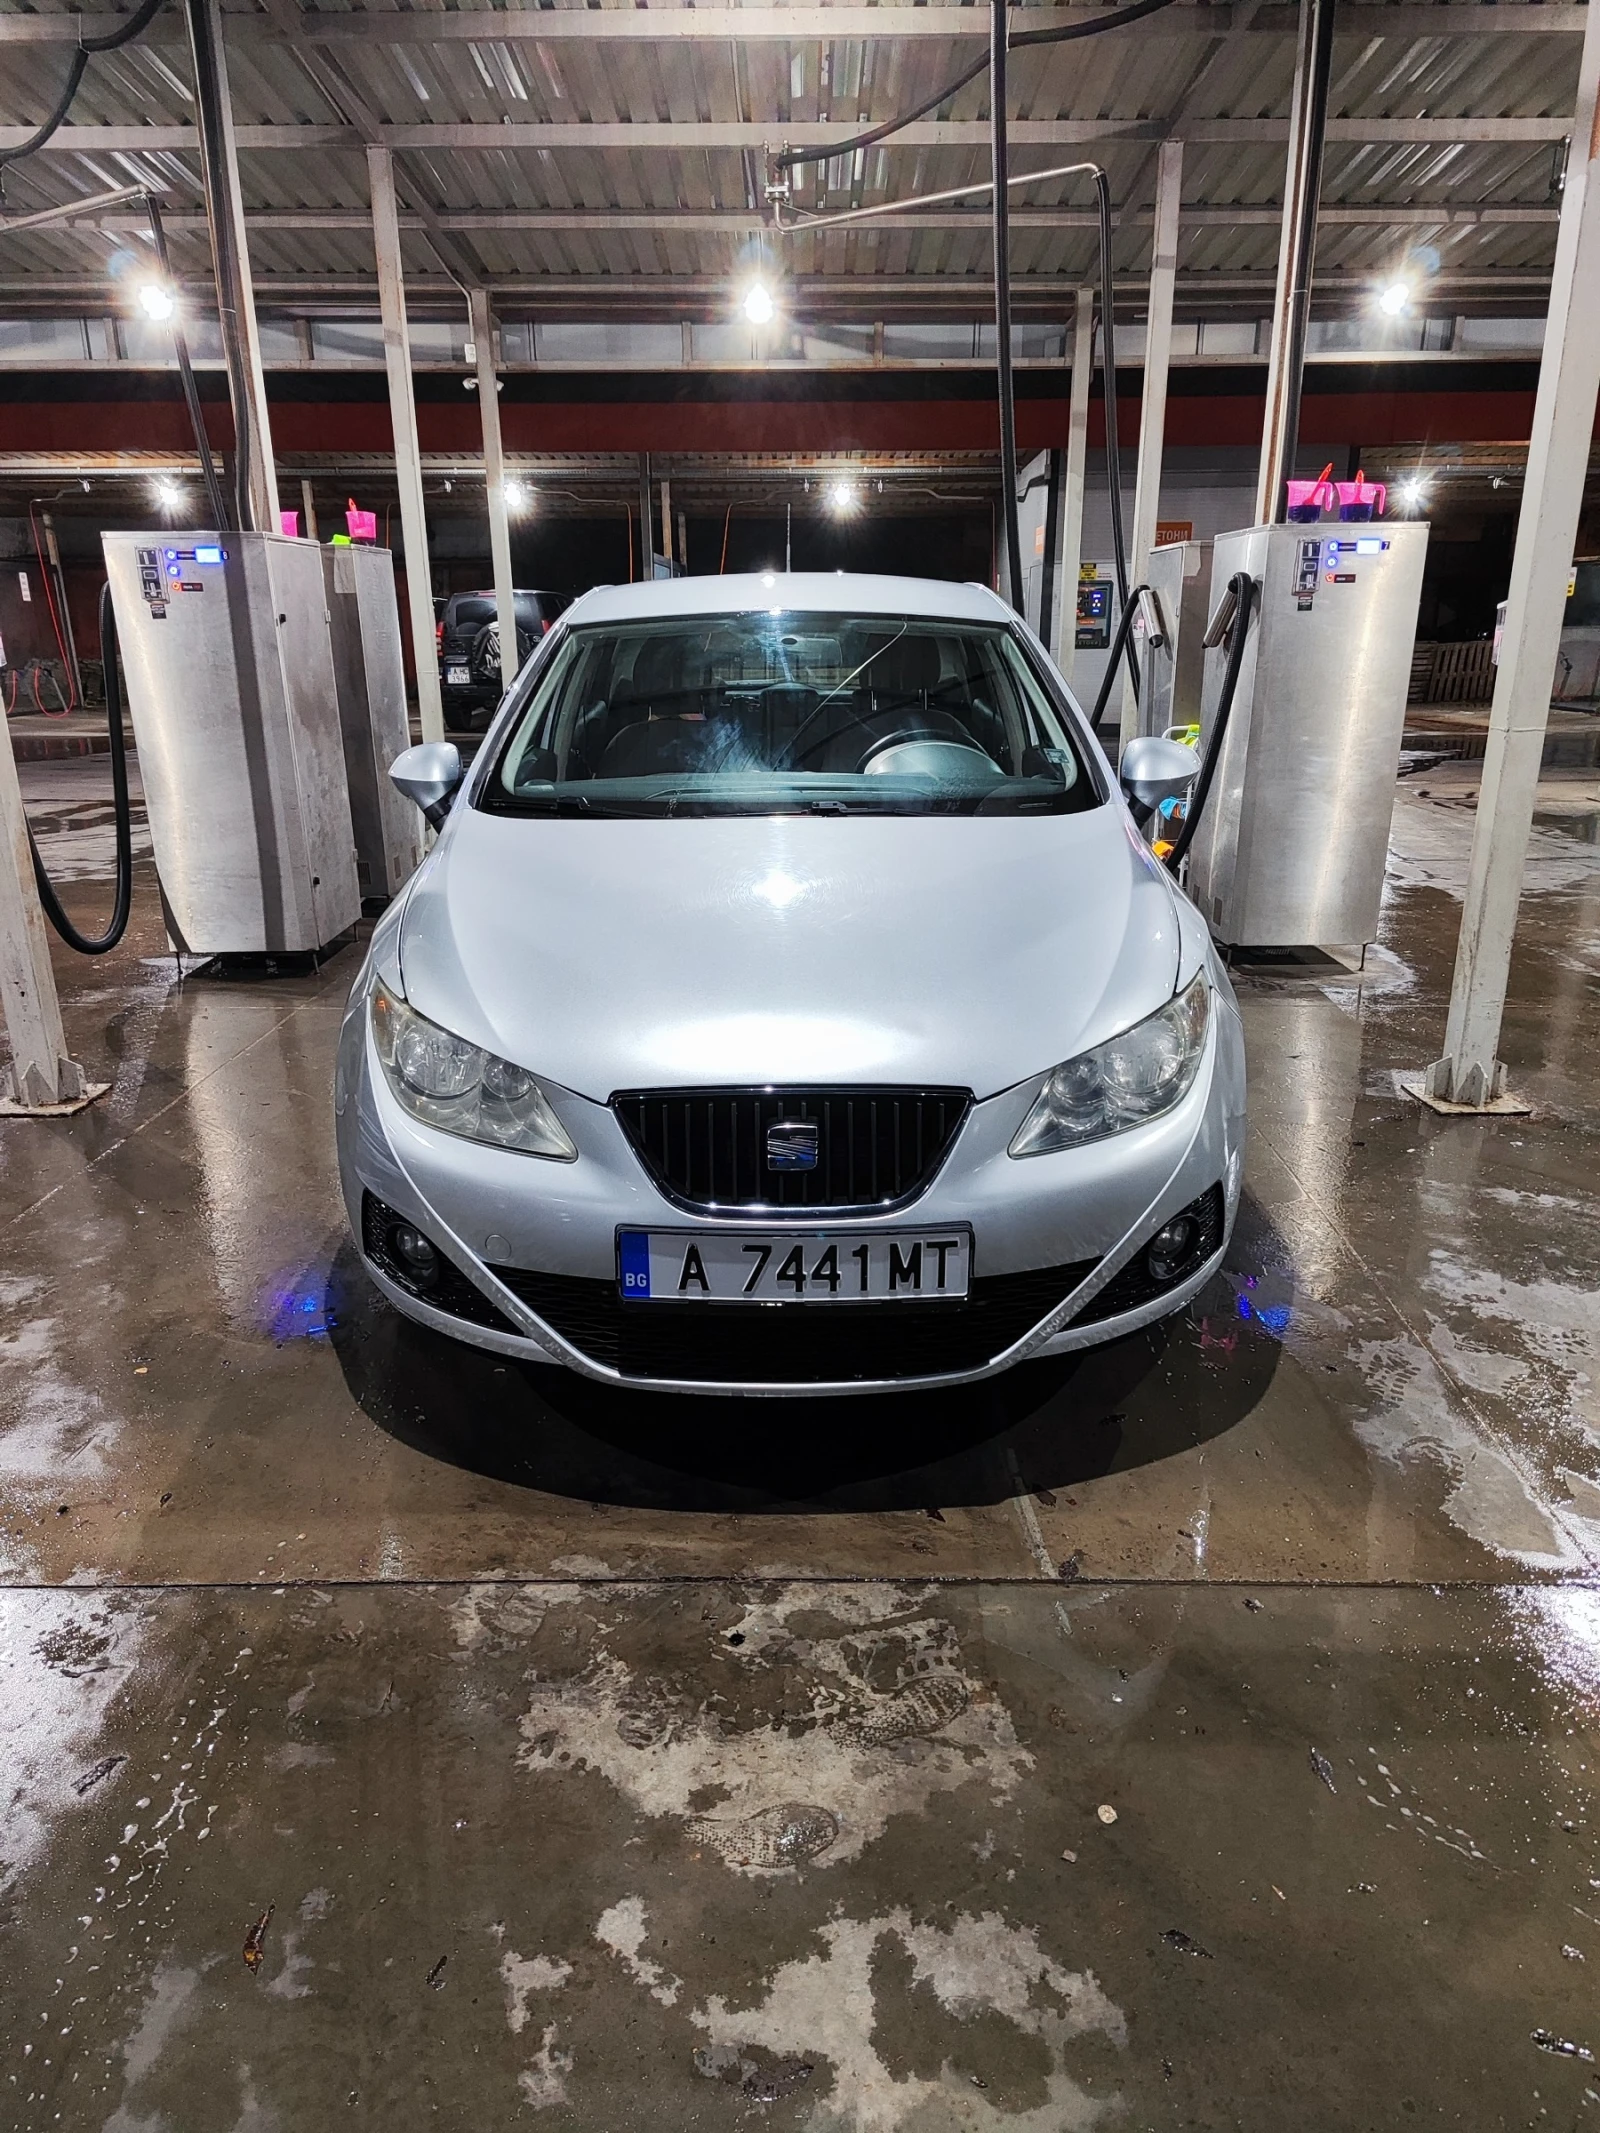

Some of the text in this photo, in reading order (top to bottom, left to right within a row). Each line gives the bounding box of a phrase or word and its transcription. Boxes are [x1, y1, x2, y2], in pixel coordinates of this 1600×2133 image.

[1156, 530, 1188, 541] ЕТОНИ
[677, 1239, 959, 1293] A 7441 MT
[625, 1273, 648, 1288] BG
